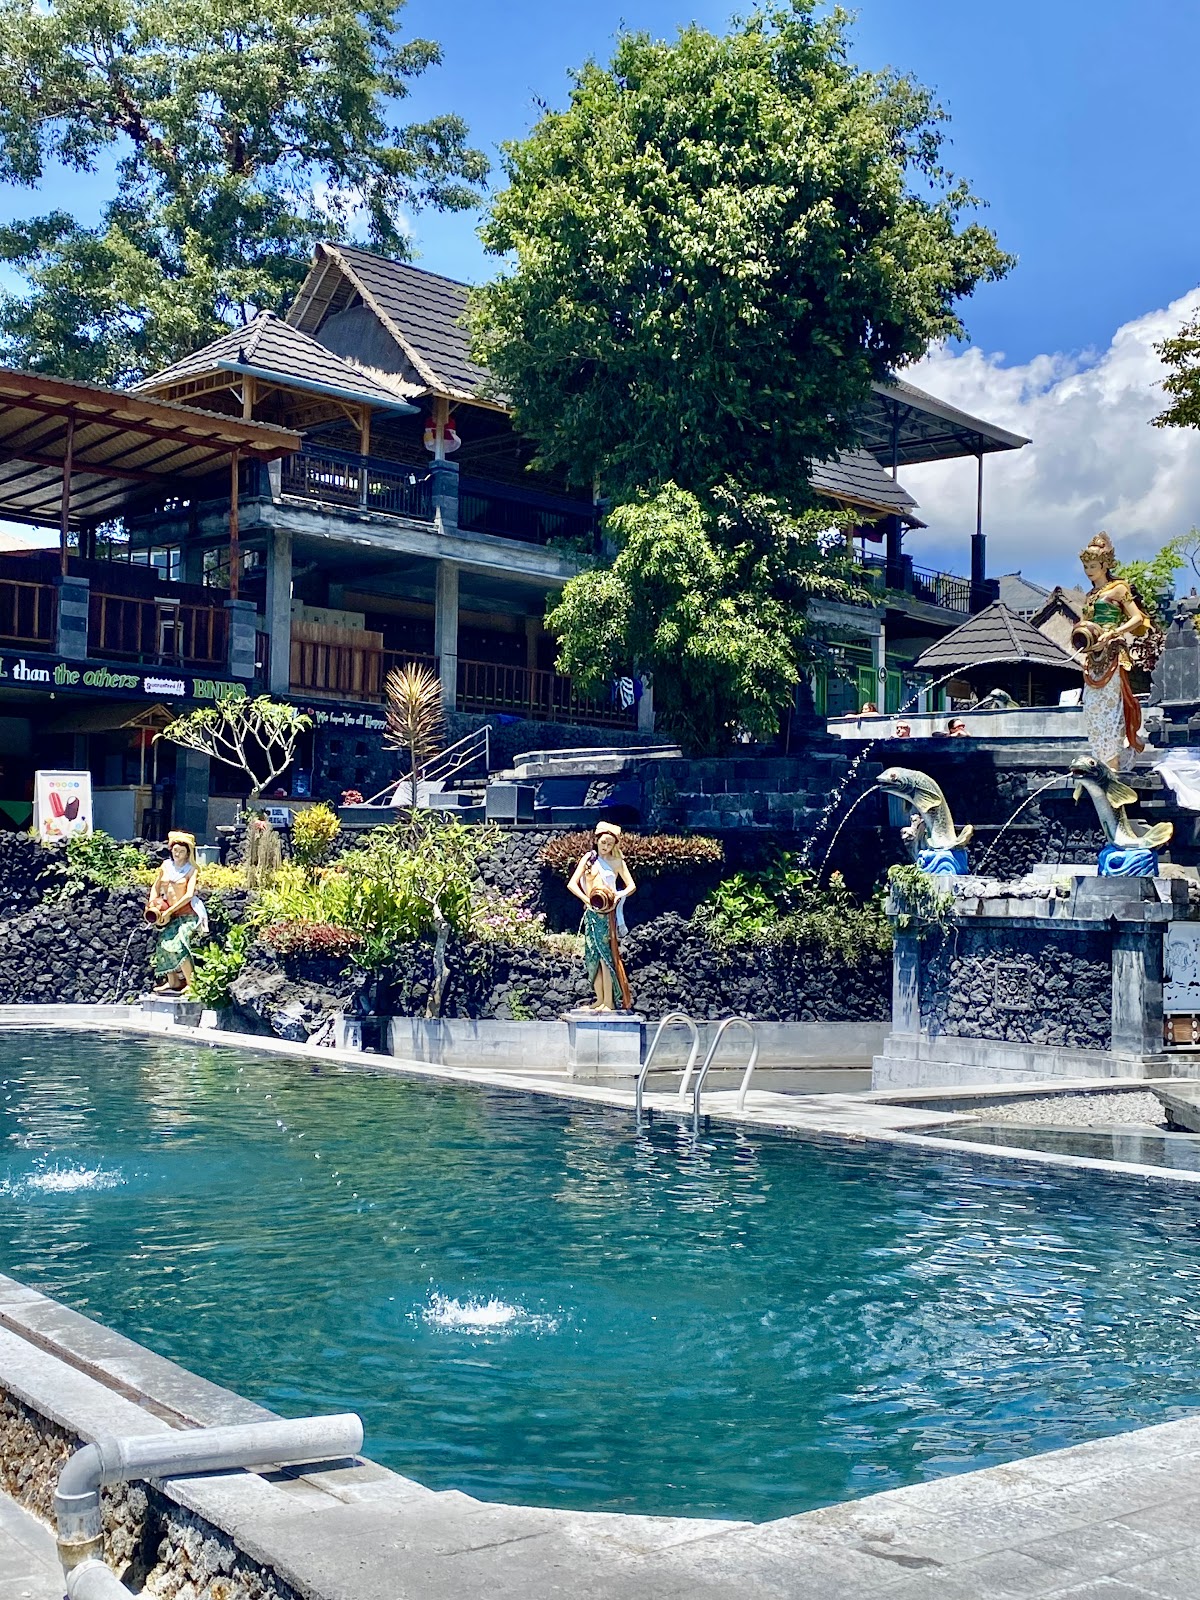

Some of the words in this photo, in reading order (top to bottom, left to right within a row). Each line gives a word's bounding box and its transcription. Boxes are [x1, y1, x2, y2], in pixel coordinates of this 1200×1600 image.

[12, 659, 50, 681] than
[53, 663, 80, 685] the
[83, 667, 141, 688] others
[315, 710, 329, 723] We
